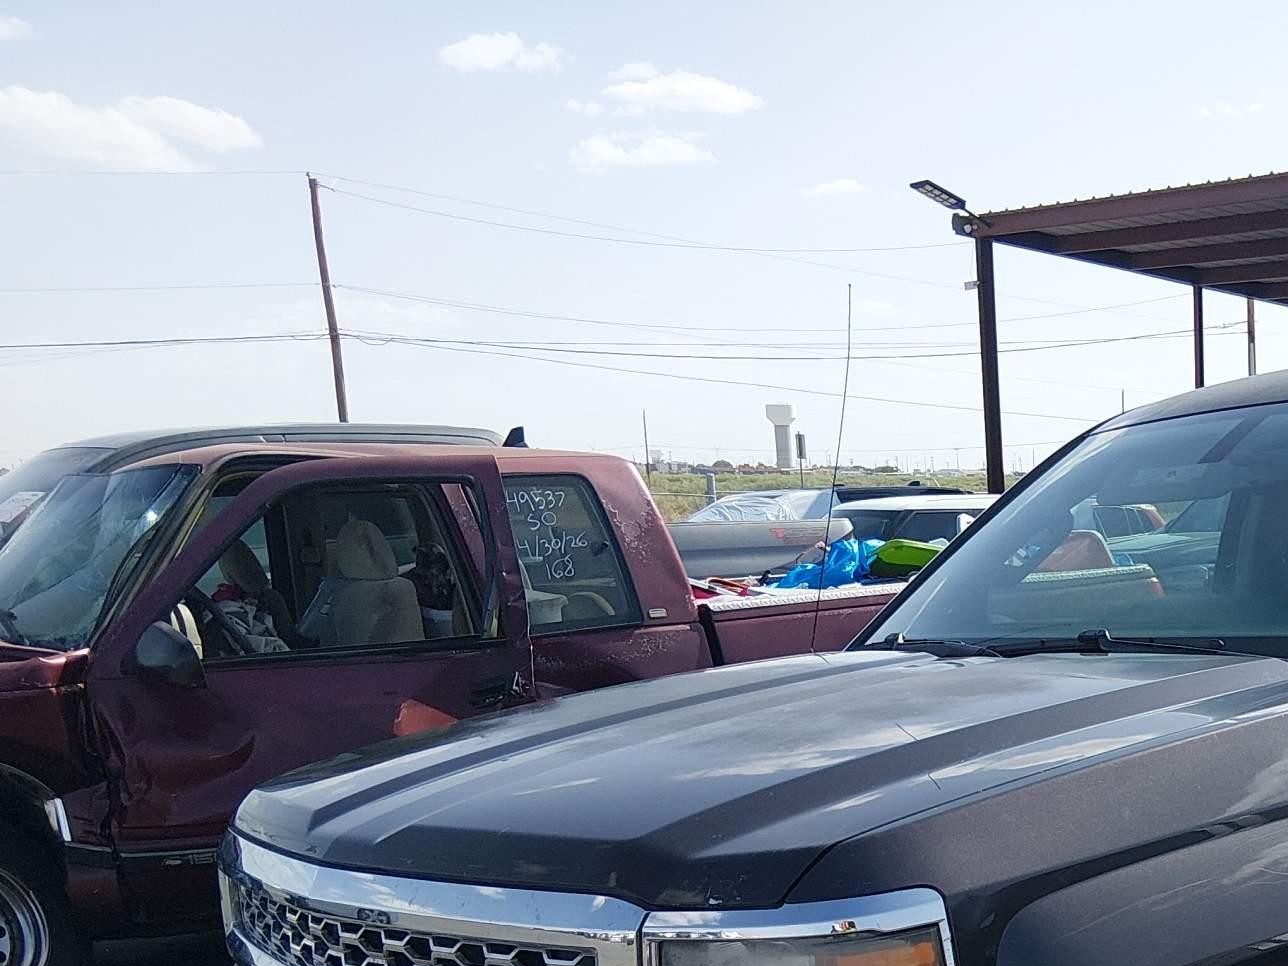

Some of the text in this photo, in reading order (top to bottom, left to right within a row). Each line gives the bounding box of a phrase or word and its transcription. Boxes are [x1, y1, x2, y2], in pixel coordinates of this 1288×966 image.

[505, 488, 566, 513] 49537
[516, 531, 588, 562] 4/30/26
[545, 553, 576, 581] 168
